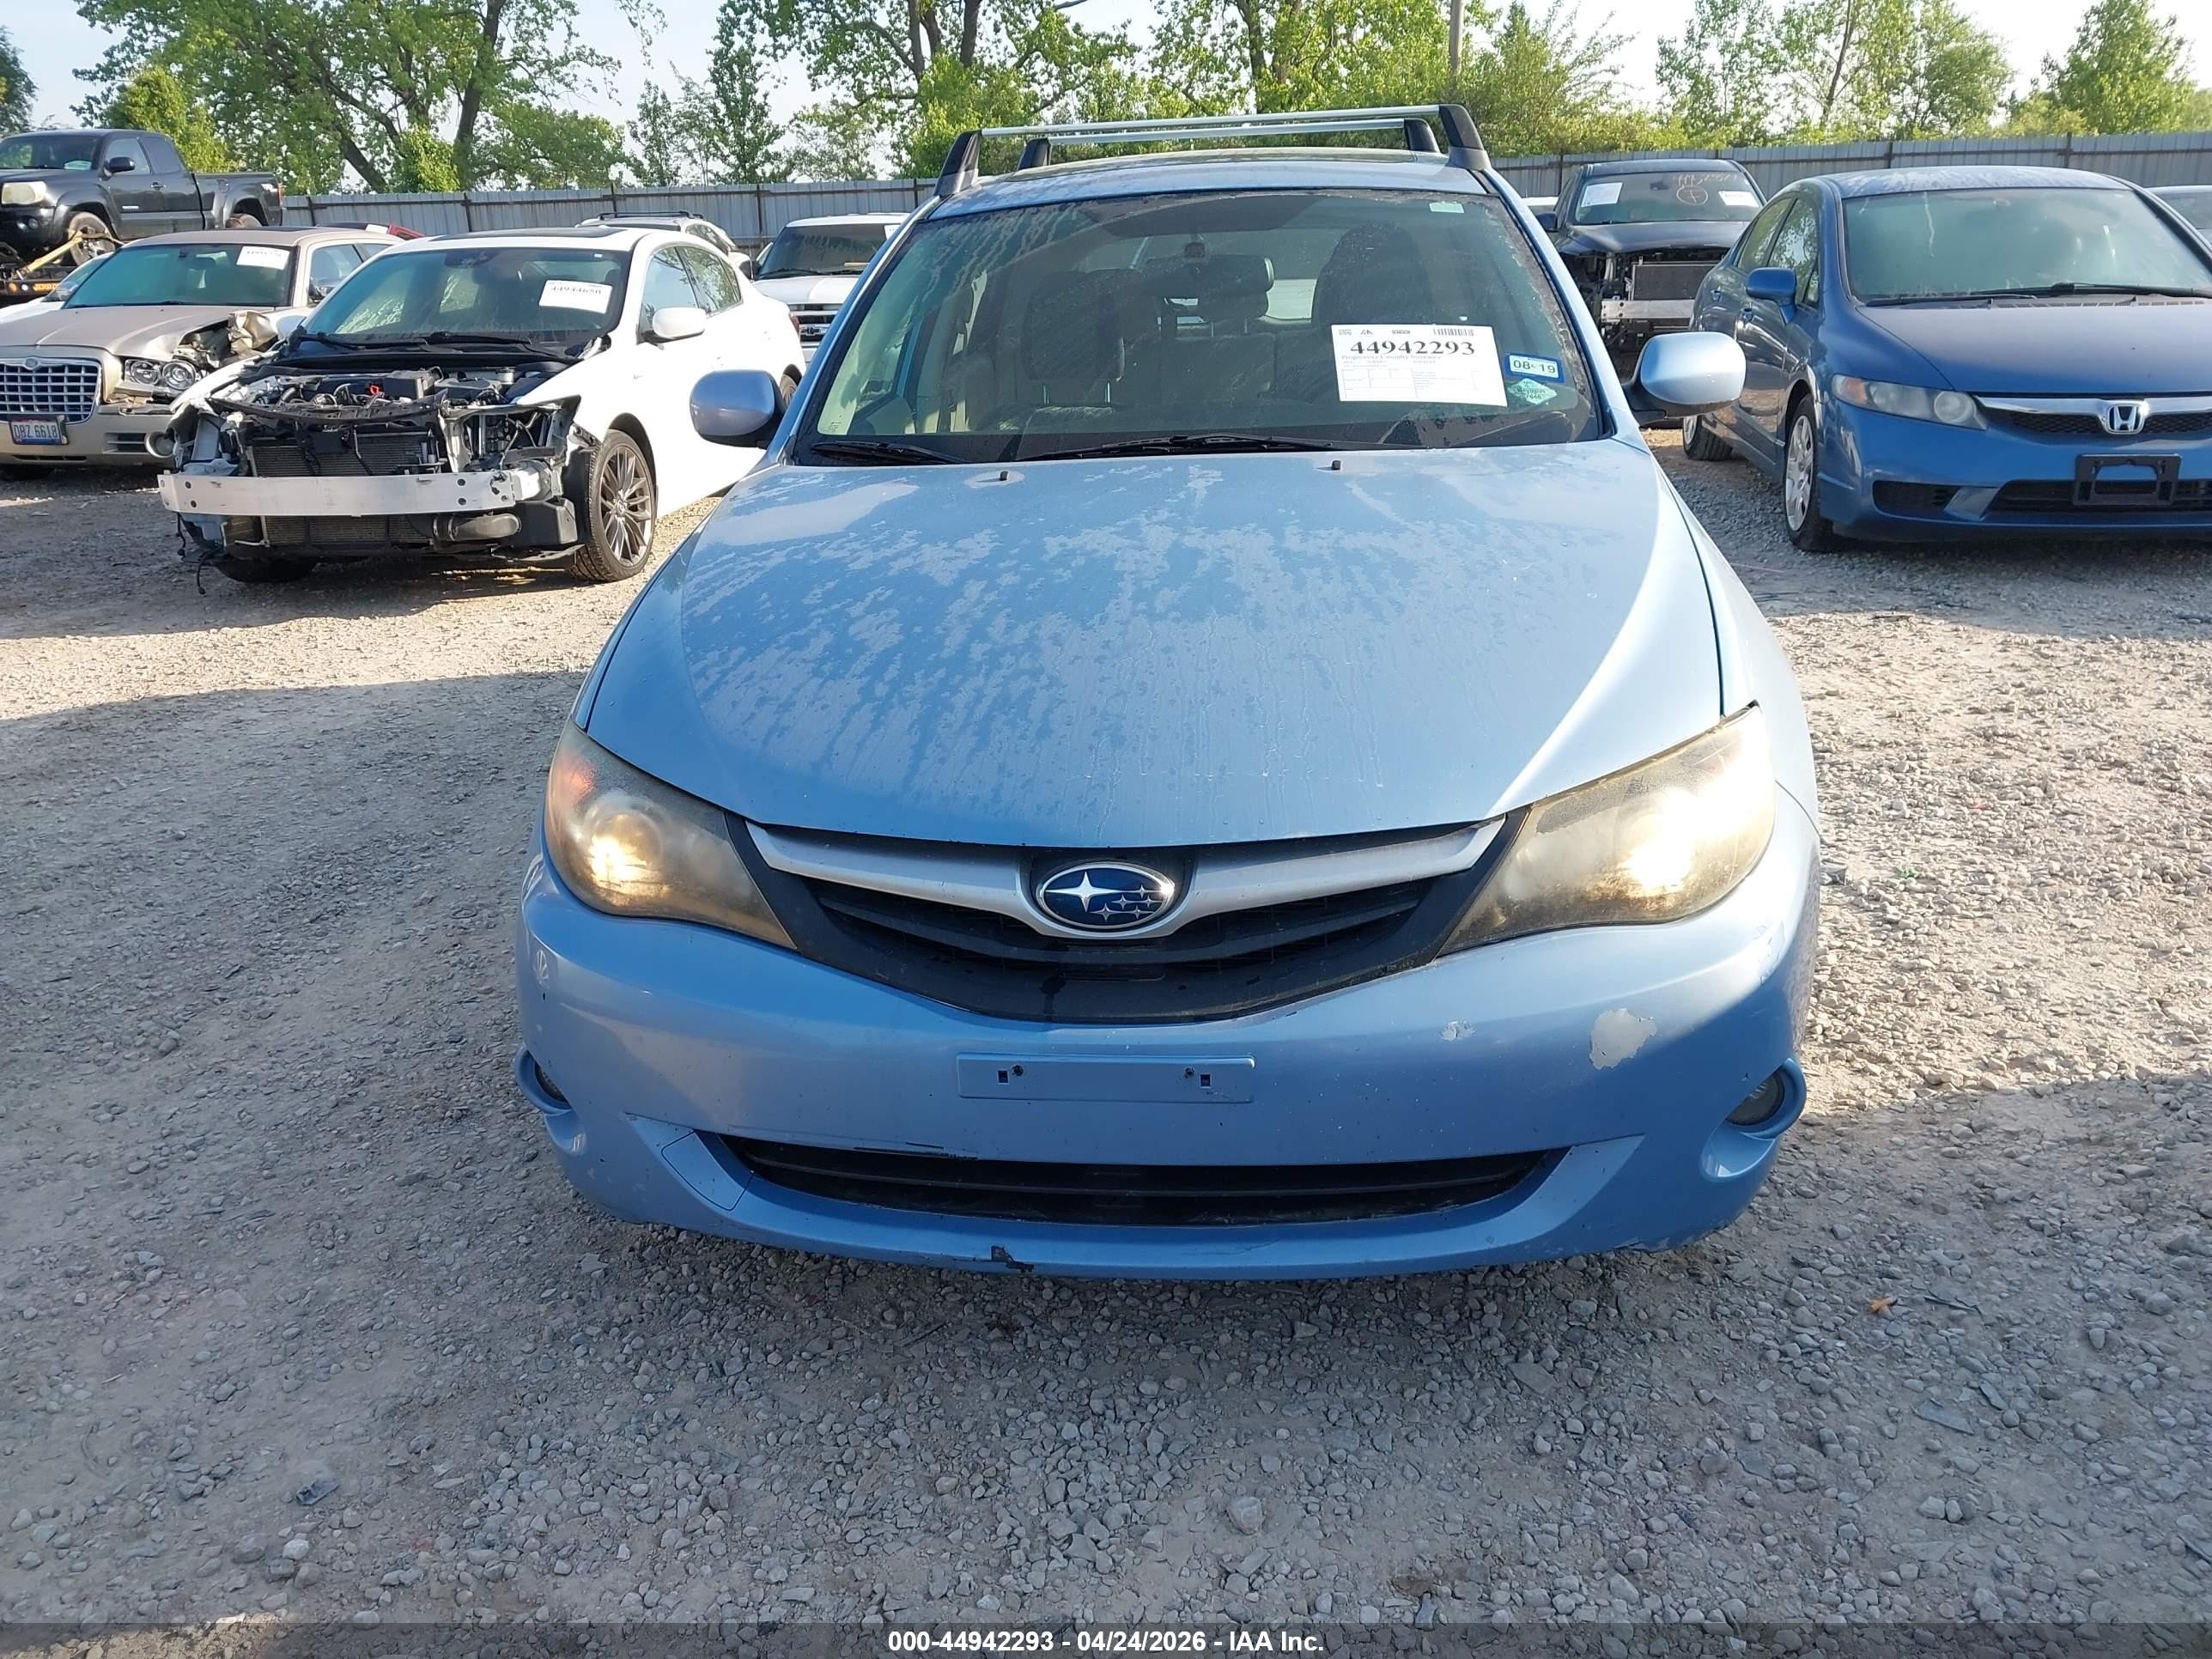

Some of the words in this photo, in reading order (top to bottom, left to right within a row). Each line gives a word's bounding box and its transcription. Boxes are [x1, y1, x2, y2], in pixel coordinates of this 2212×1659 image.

[1350, 340, 1475, 355] 44942293
[1513, 360, 1531, 369] 08
[1539, 363, 1556, 374] 19
[34, 424, 58, 438] 6618
